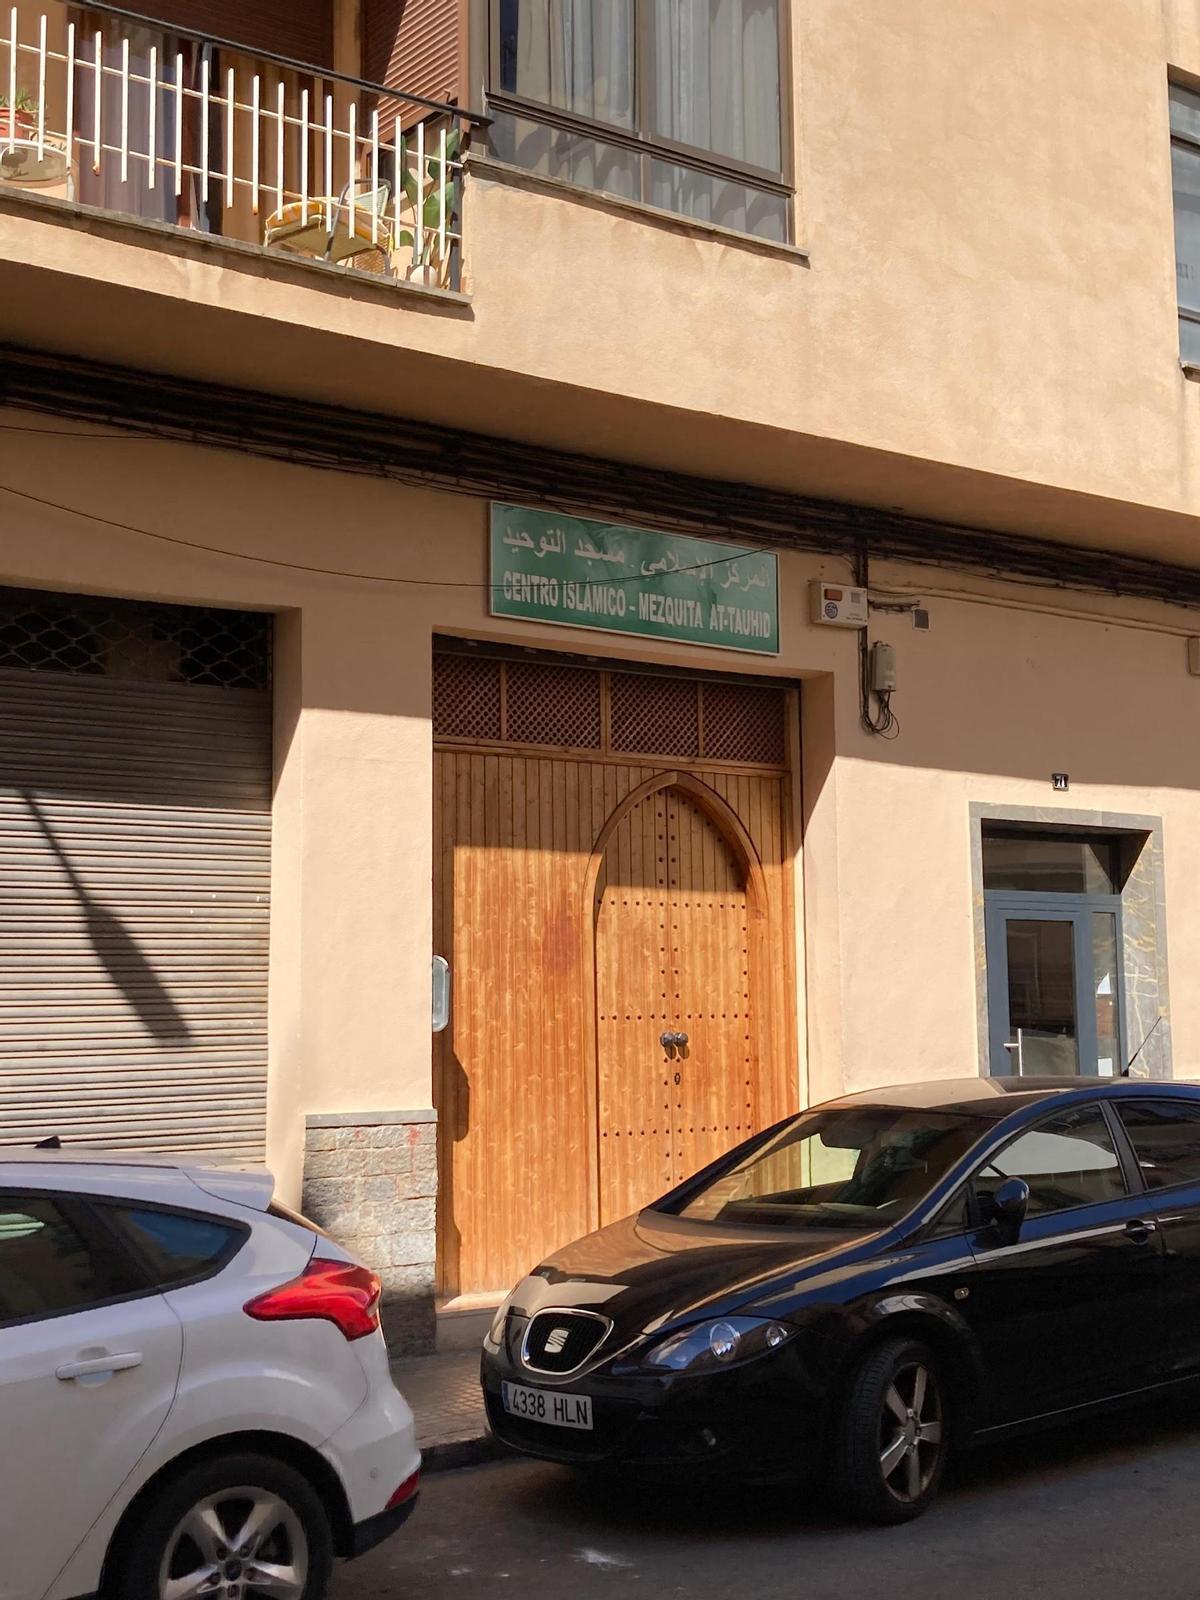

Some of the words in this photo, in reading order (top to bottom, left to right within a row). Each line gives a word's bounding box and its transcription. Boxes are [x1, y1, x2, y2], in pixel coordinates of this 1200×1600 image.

[502, 526, 566, 558] التوحيد
[574, 538, 625, 567] مسجد
[720, 562, 769, 592] المركز
[503, 570, 559, 608] CENTRO
[562, 577, 627, 617] ISLÁMICO
[639, 592, 704, 628] MEZQUITA
[710, 604, 771, 639] AT-TAUHID
[512, 1388, 546, 1418] 4338
[553, 1397, 589, 1425] HLN
